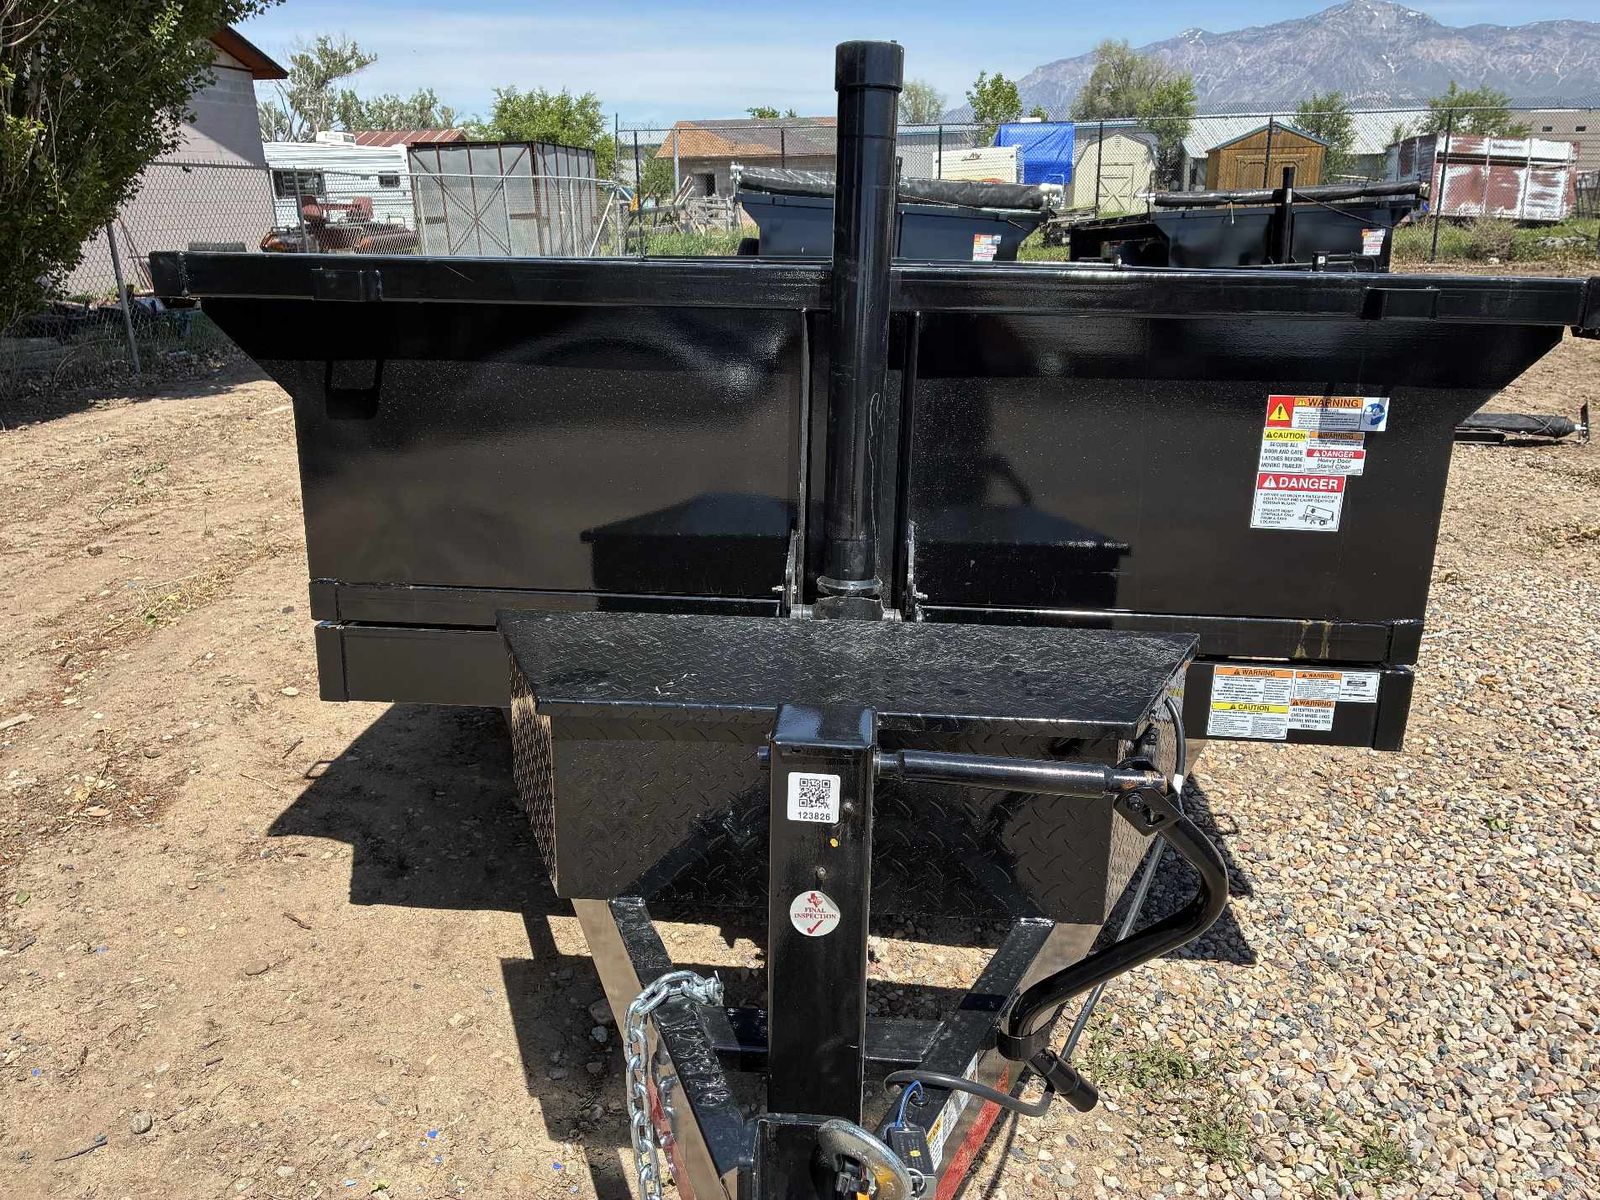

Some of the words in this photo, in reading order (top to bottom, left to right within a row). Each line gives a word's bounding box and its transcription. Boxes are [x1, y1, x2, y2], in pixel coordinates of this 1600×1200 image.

[1308, 398, 1359, 407] WARNING
[1273, 431, 1306, 440] CAUTION
[1279, 477, 1338, 489] DANGER
[1242, 669, 1276, 677] WARNING
[1238, 703, 1270, 711] CAUTION
[798, 811, 830, 821] 123826
[794, 912, 837, 920] INSPECTION
